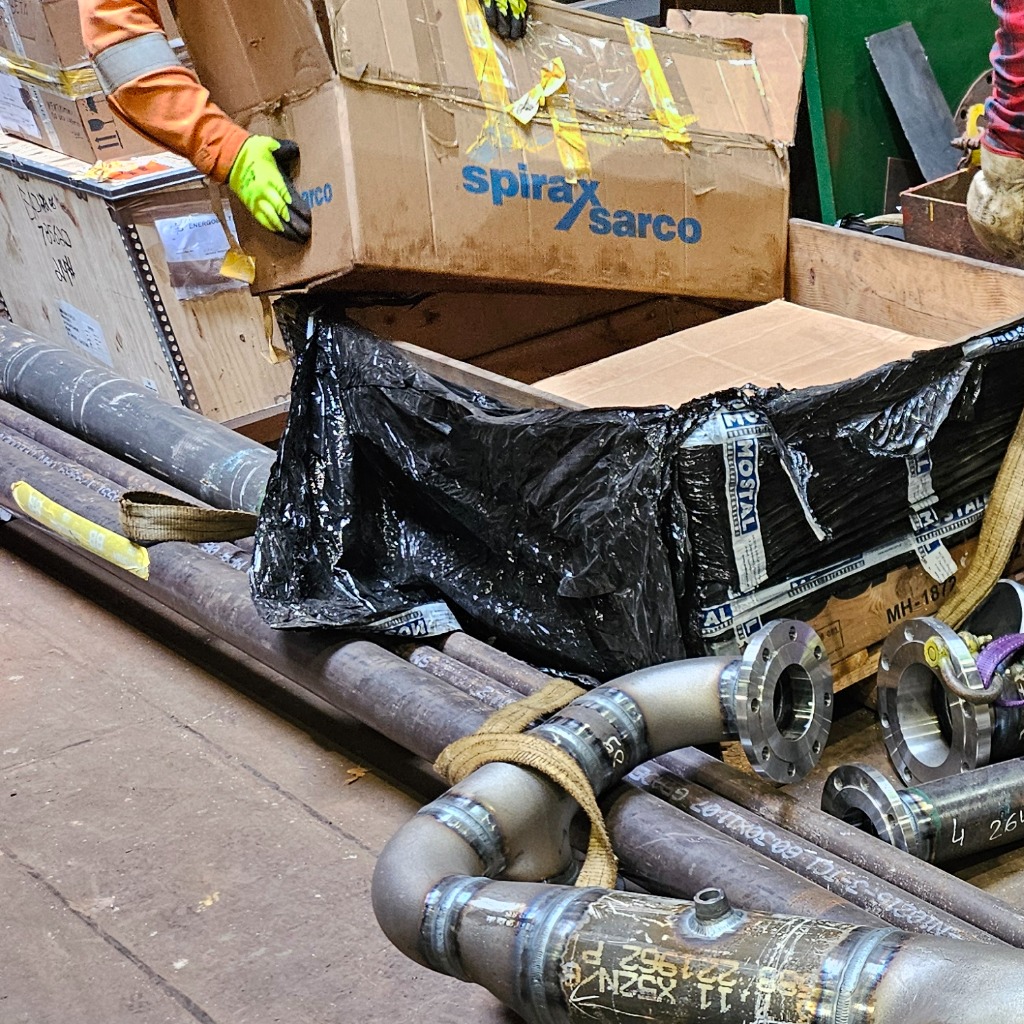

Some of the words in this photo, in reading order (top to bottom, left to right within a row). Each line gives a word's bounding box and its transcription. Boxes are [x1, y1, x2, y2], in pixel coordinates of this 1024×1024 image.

[301, 183, 333, 209] arco
[462, 163, 602, 230] spirax
[588, 206, 702, 244] sarco
[736, 439, 757, 533] MOSTAL
[951, 818, 965, 846] 4
[619, 944, 740, 987] 221962
